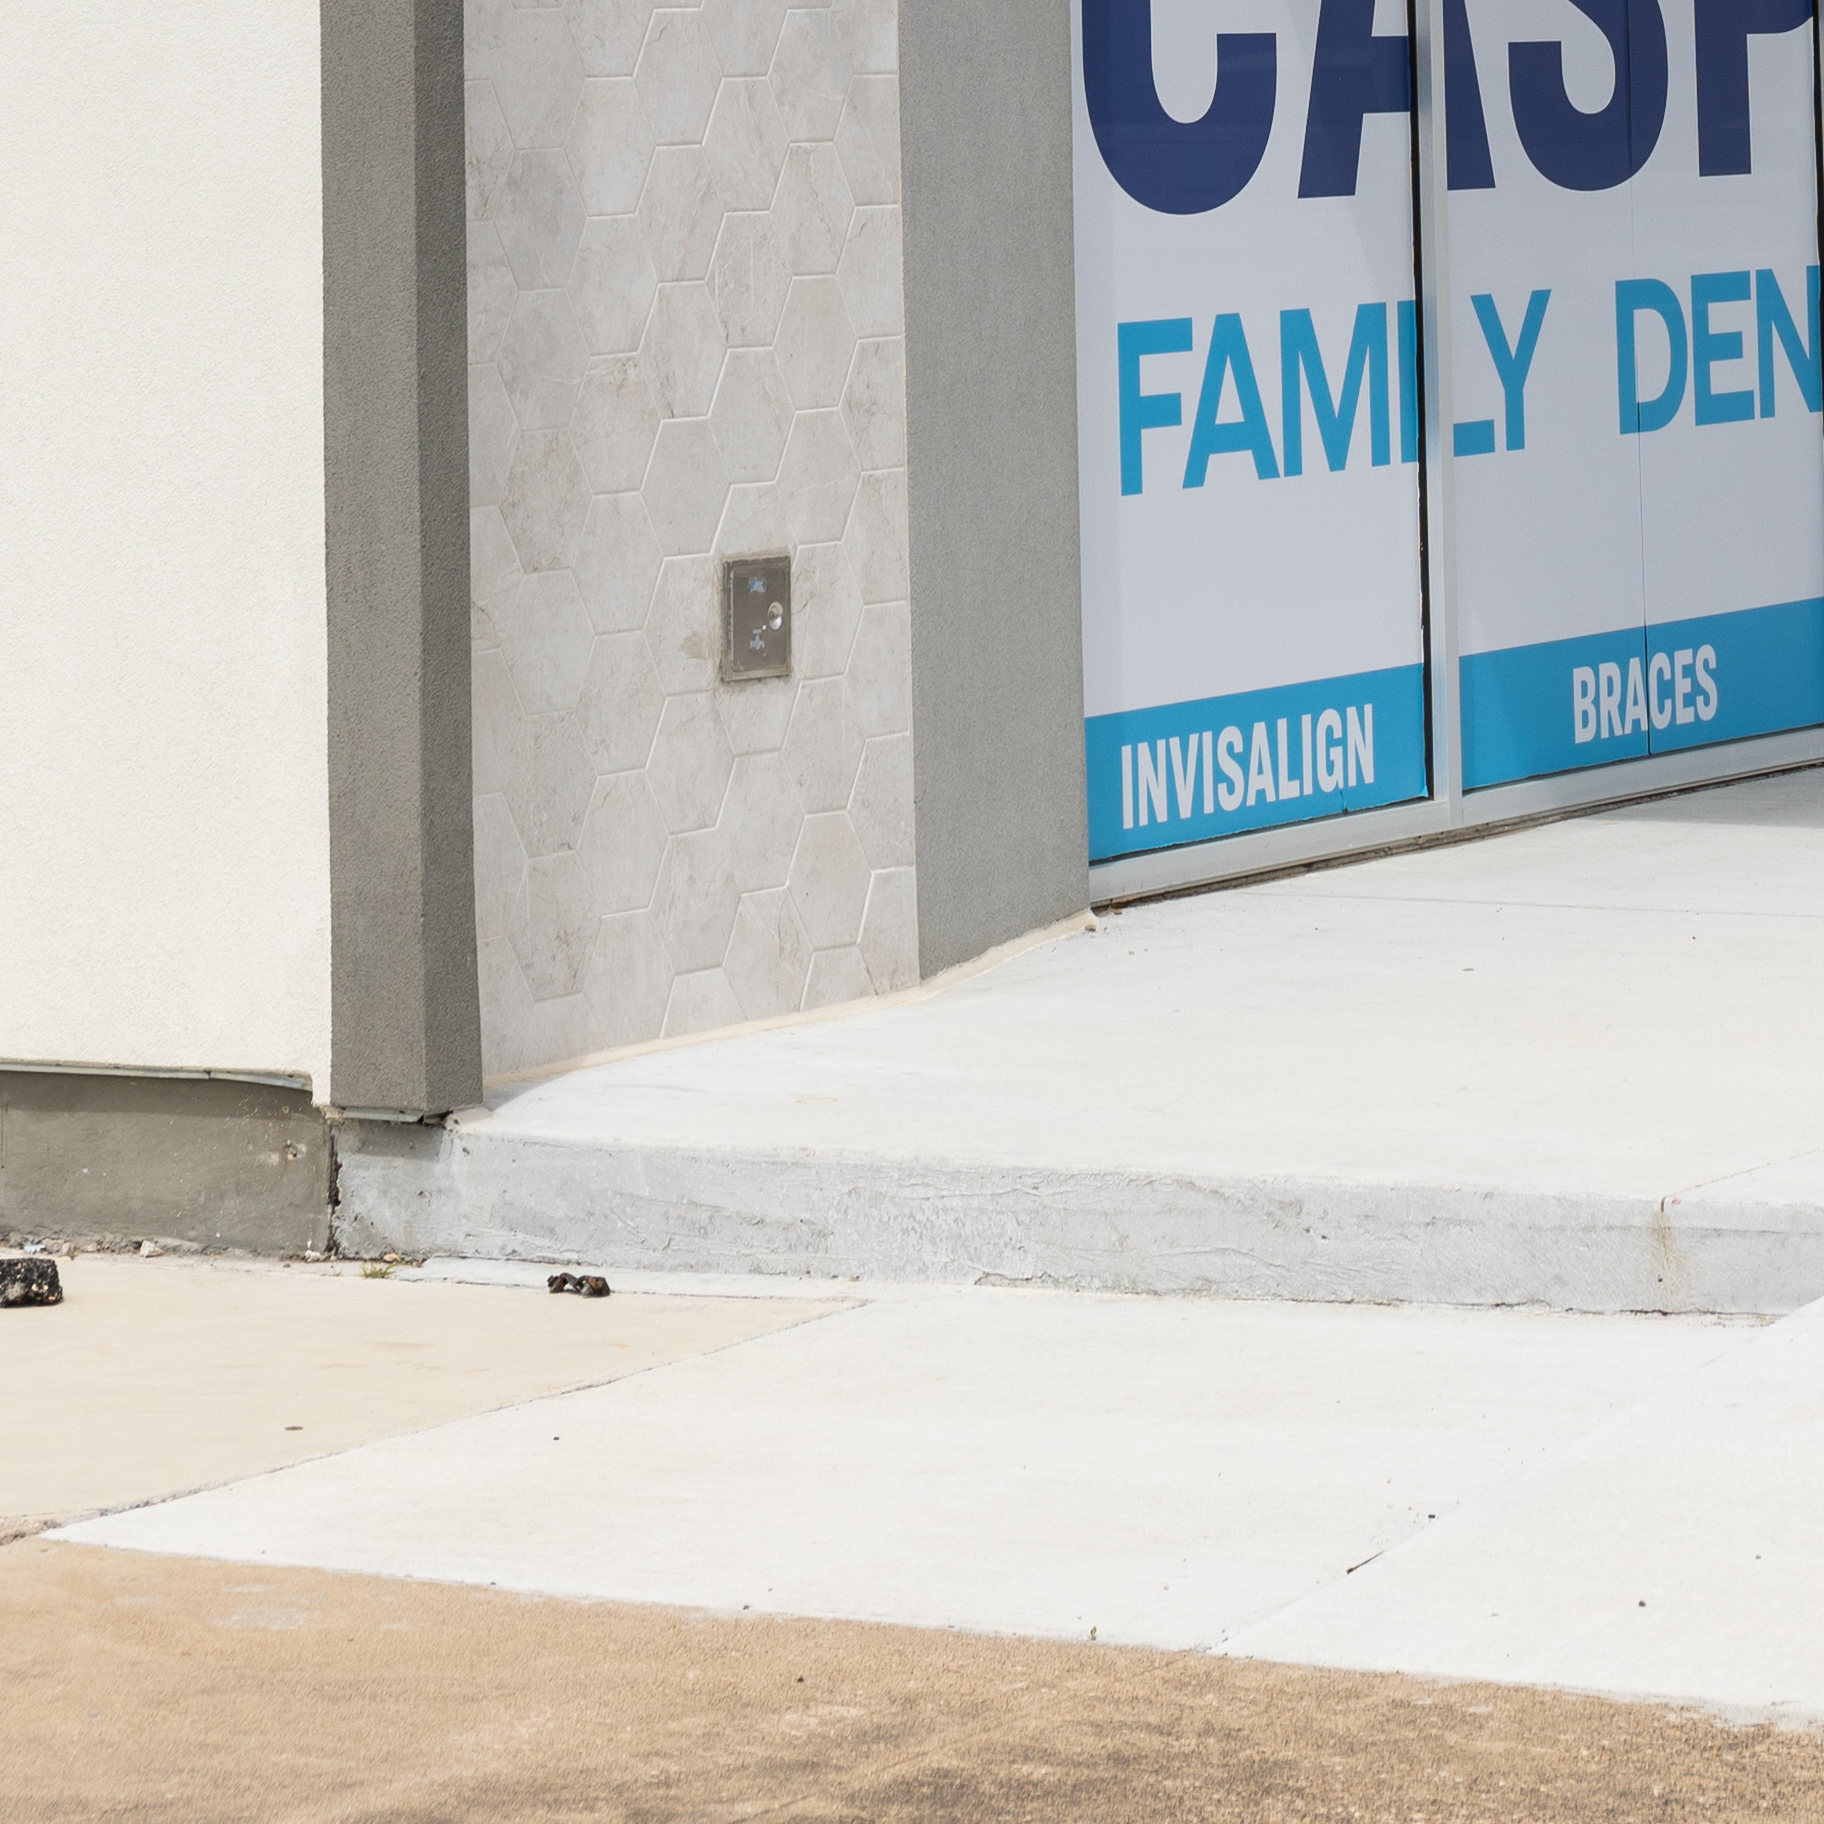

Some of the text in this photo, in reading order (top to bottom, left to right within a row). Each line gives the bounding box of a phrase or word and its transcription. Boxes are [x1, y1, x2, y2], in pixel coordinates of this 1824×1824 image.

[1117, 288, 1552, 497] FAMIY
[1572, 644, 1718, 744] BRACES
[1121, 703, 1375, 830] INVISALIGN
